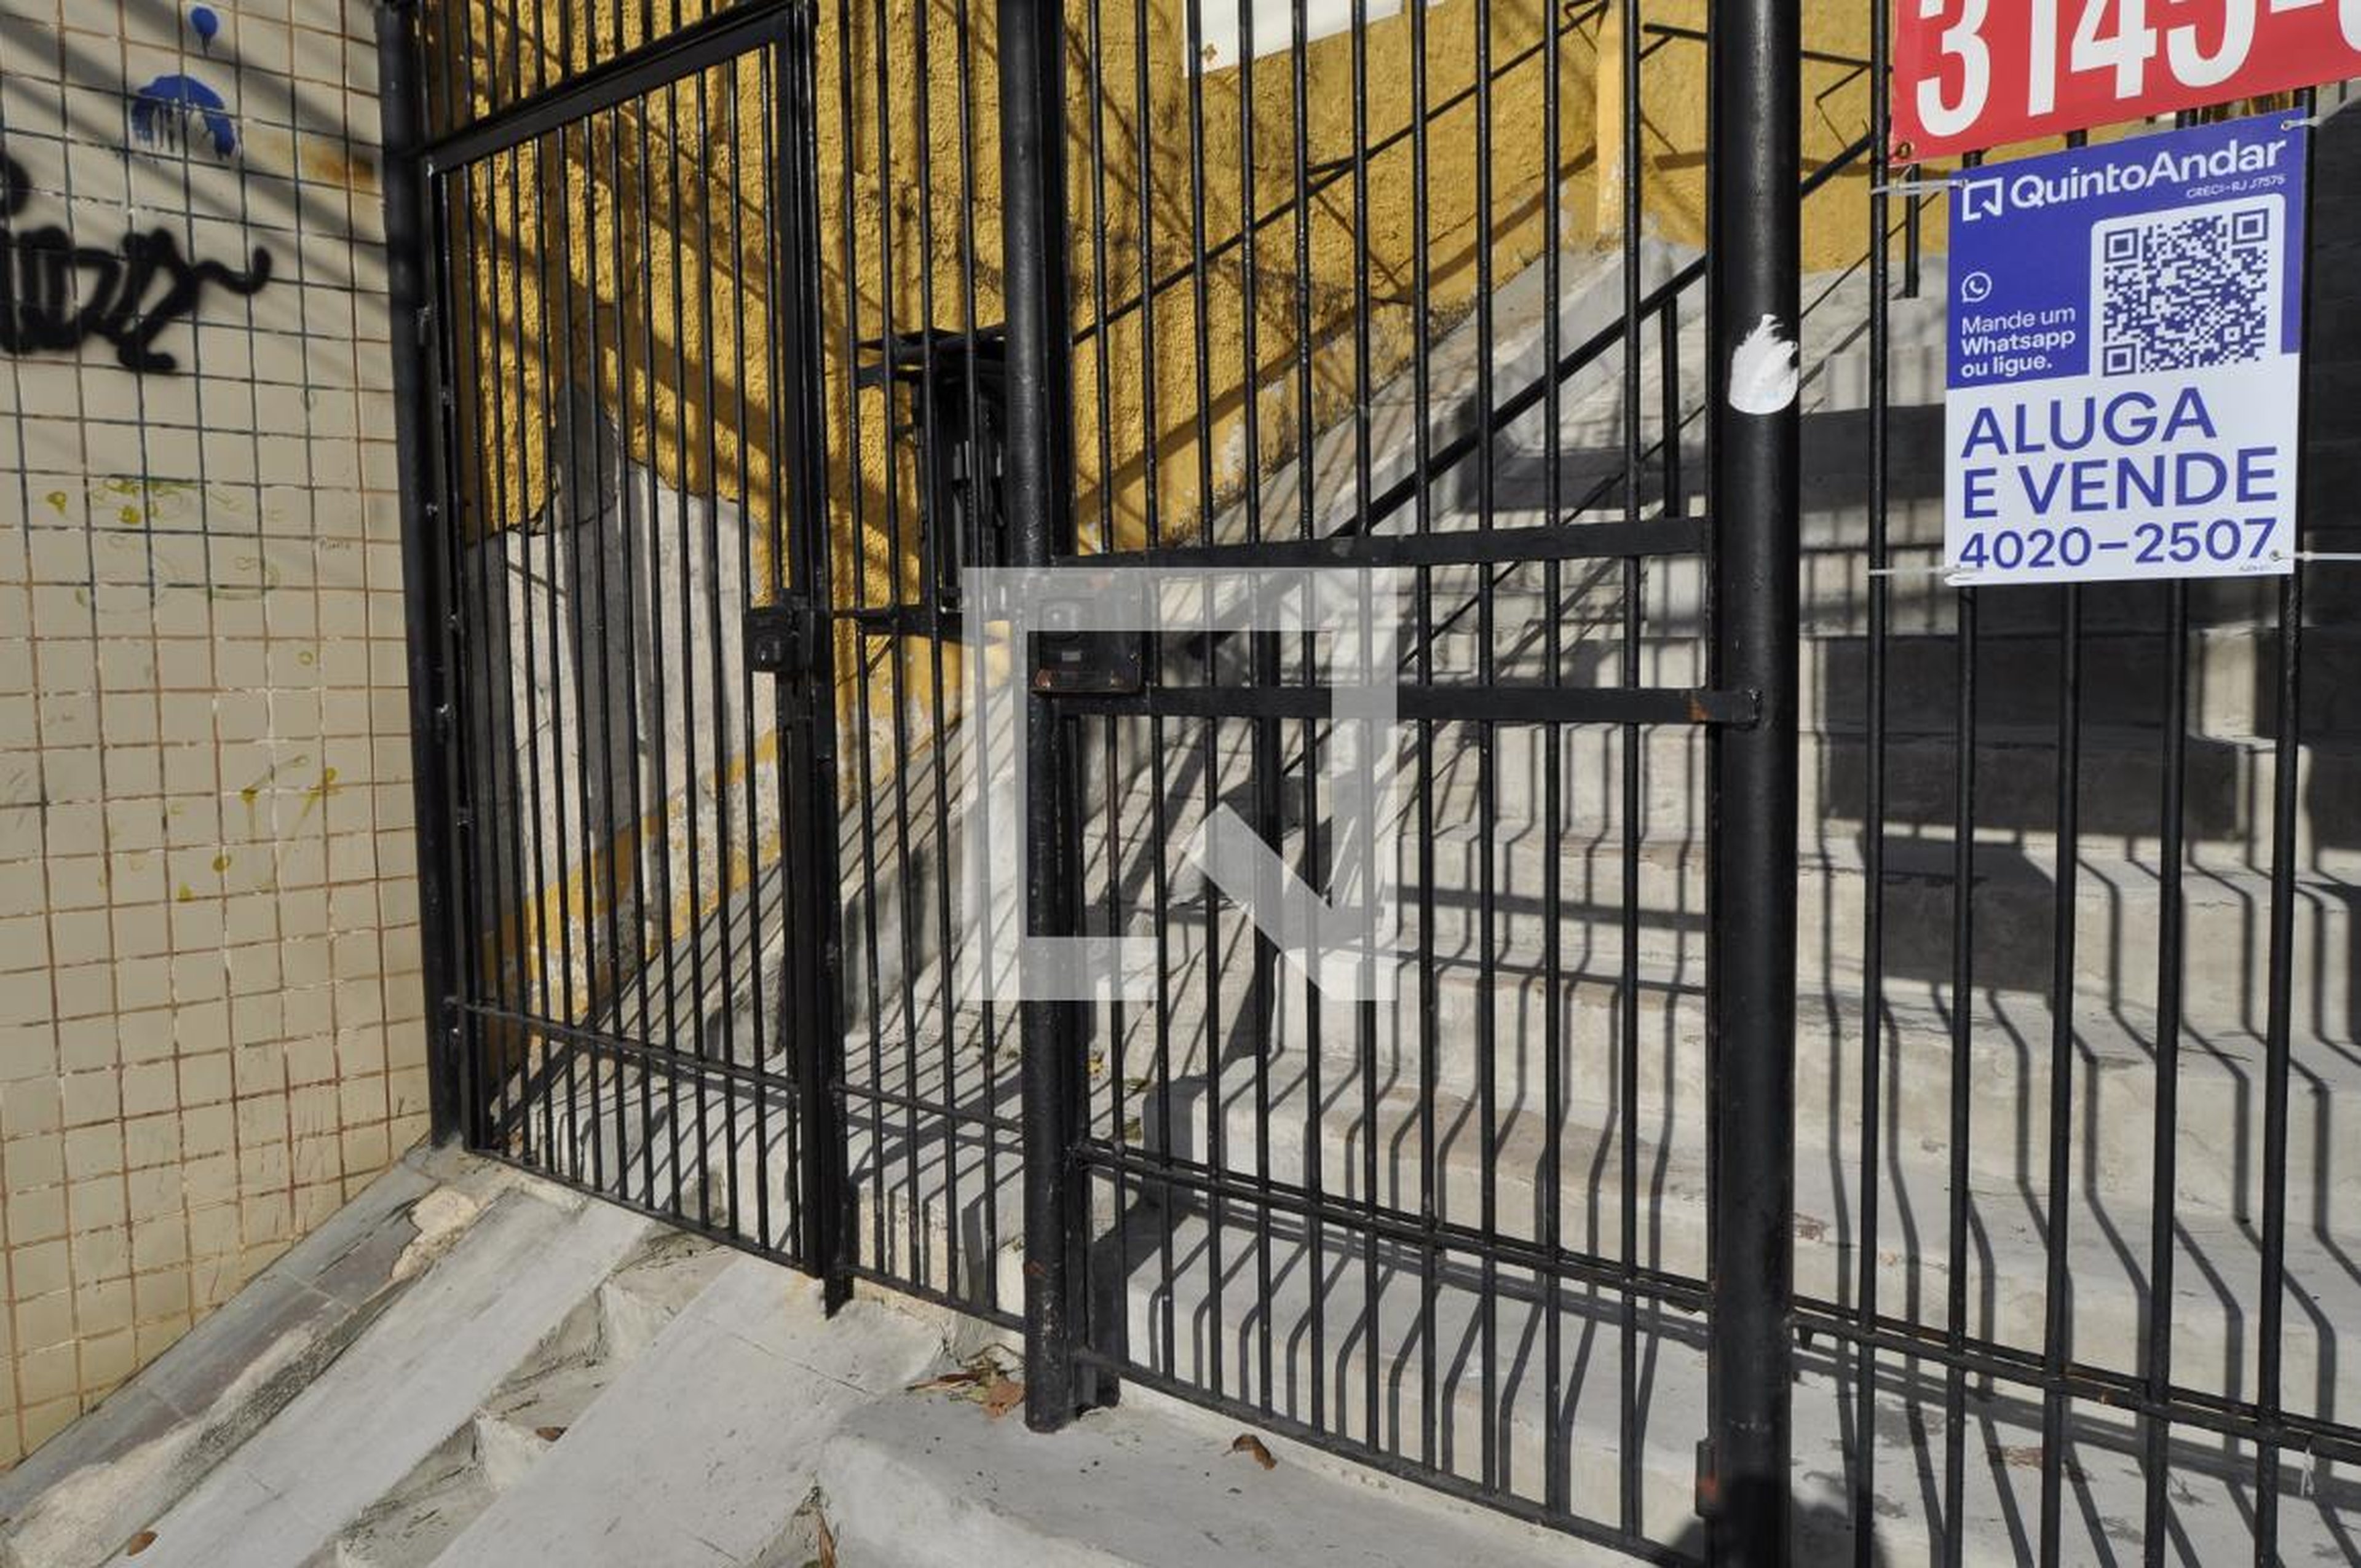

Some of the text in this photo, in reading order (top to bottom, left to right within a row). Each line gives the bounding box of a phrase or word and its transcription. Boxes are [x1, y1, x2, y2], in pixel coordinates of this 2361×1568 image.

[1916, 0, 2361, 137] 3145-
[2010, 139, 2287, 210] QuintoAndar
[1961, 307, 2076, 336] Mande um
[1961, 330, 2076, 357] Whatsapp
[1961, 355, 2052, 377] ou ligue.
[1961, 387, 2217, 458] ALUGA
[1964, 447, 2277, 518] E VENDE
[1960, 518, 2276, 569] 4020-2507
